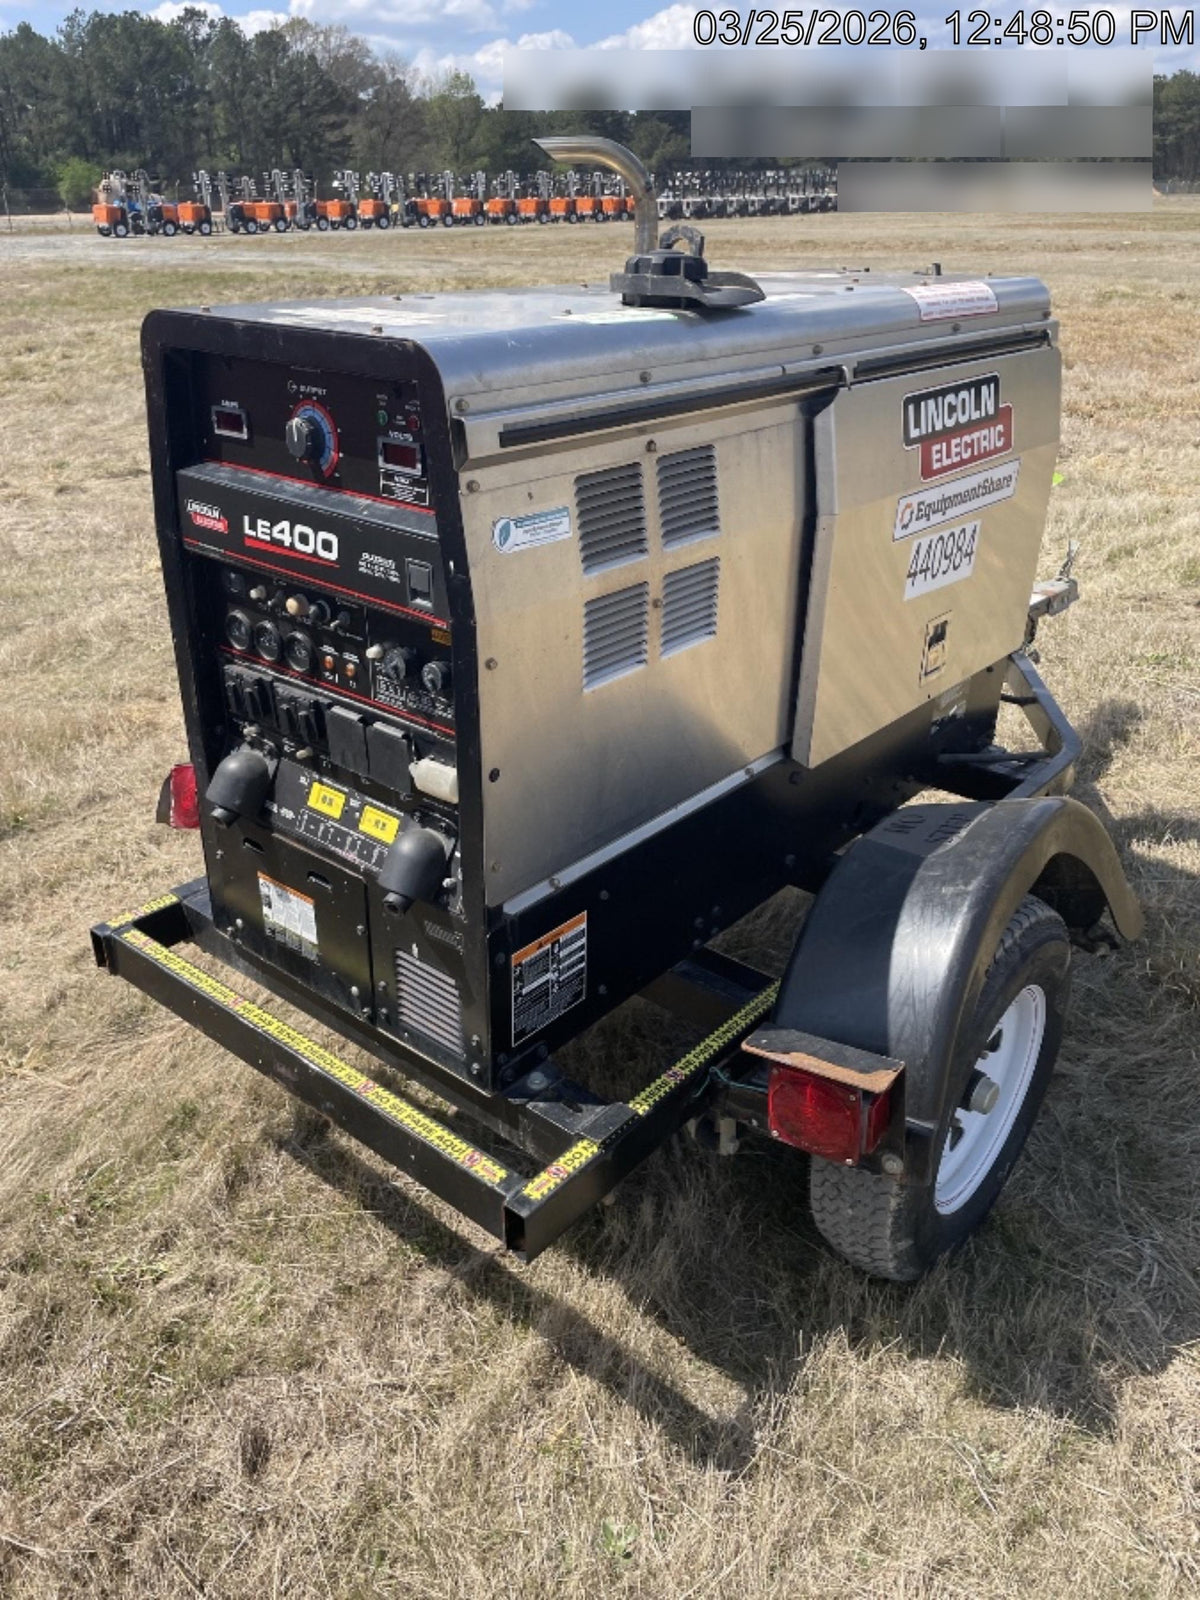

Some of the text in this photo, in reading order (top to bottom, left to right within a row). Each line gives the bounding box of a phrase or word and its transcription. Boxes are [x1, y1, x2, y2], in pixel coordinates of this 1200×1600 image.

[907, 381, 997, 440] LINCOLN
[931, 423, 1005, 471] ELECTRIC
[914, 473, 1013, 523] EquipmentShare
[242, 515, 339, 562] LE400
[906, 524, 978, 587] 440984
[563, 1149, 584, 1167] DO
